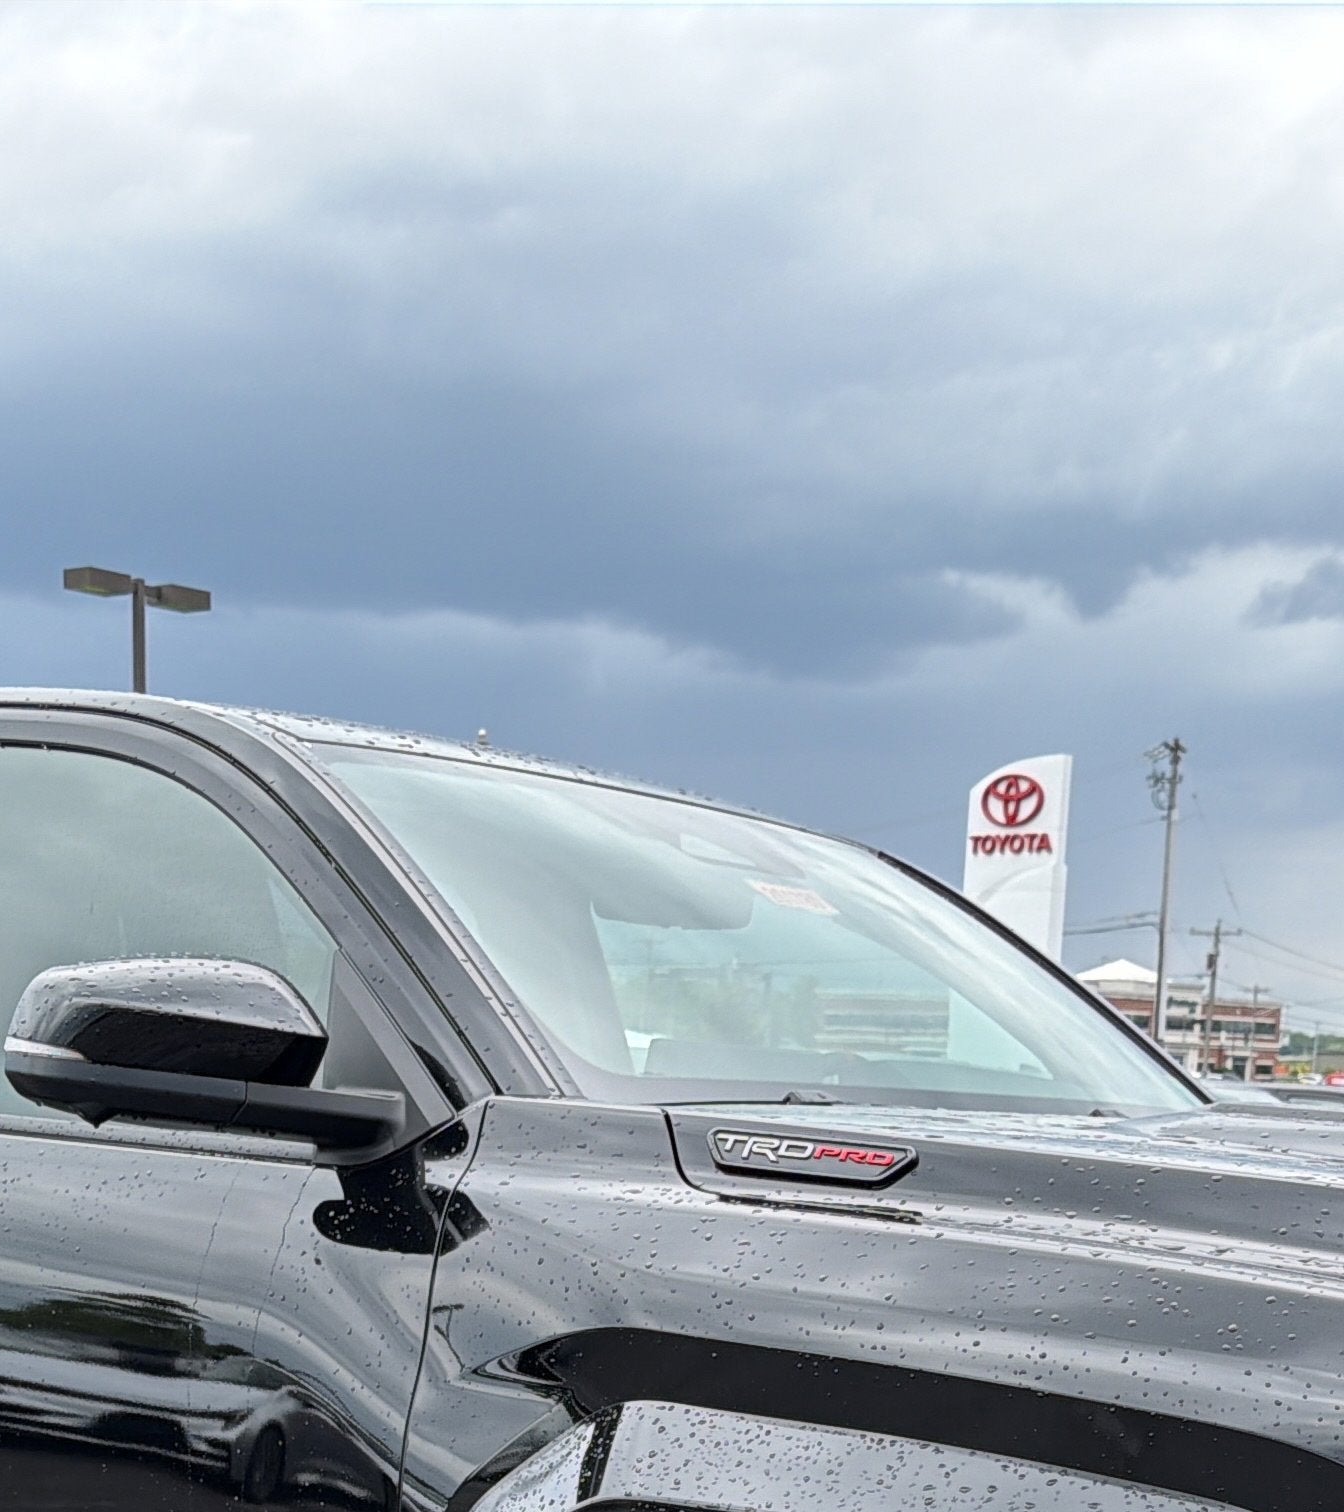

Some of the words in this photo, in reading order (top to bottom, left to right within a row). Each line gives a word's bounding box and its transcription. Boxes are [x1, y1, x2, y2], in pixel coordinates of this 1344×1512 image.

[970, 833, 1052, 856] TOYOTA
[716, 1133, 816, 1164] TRD
[812, 1145, 895, 1167] PRO
